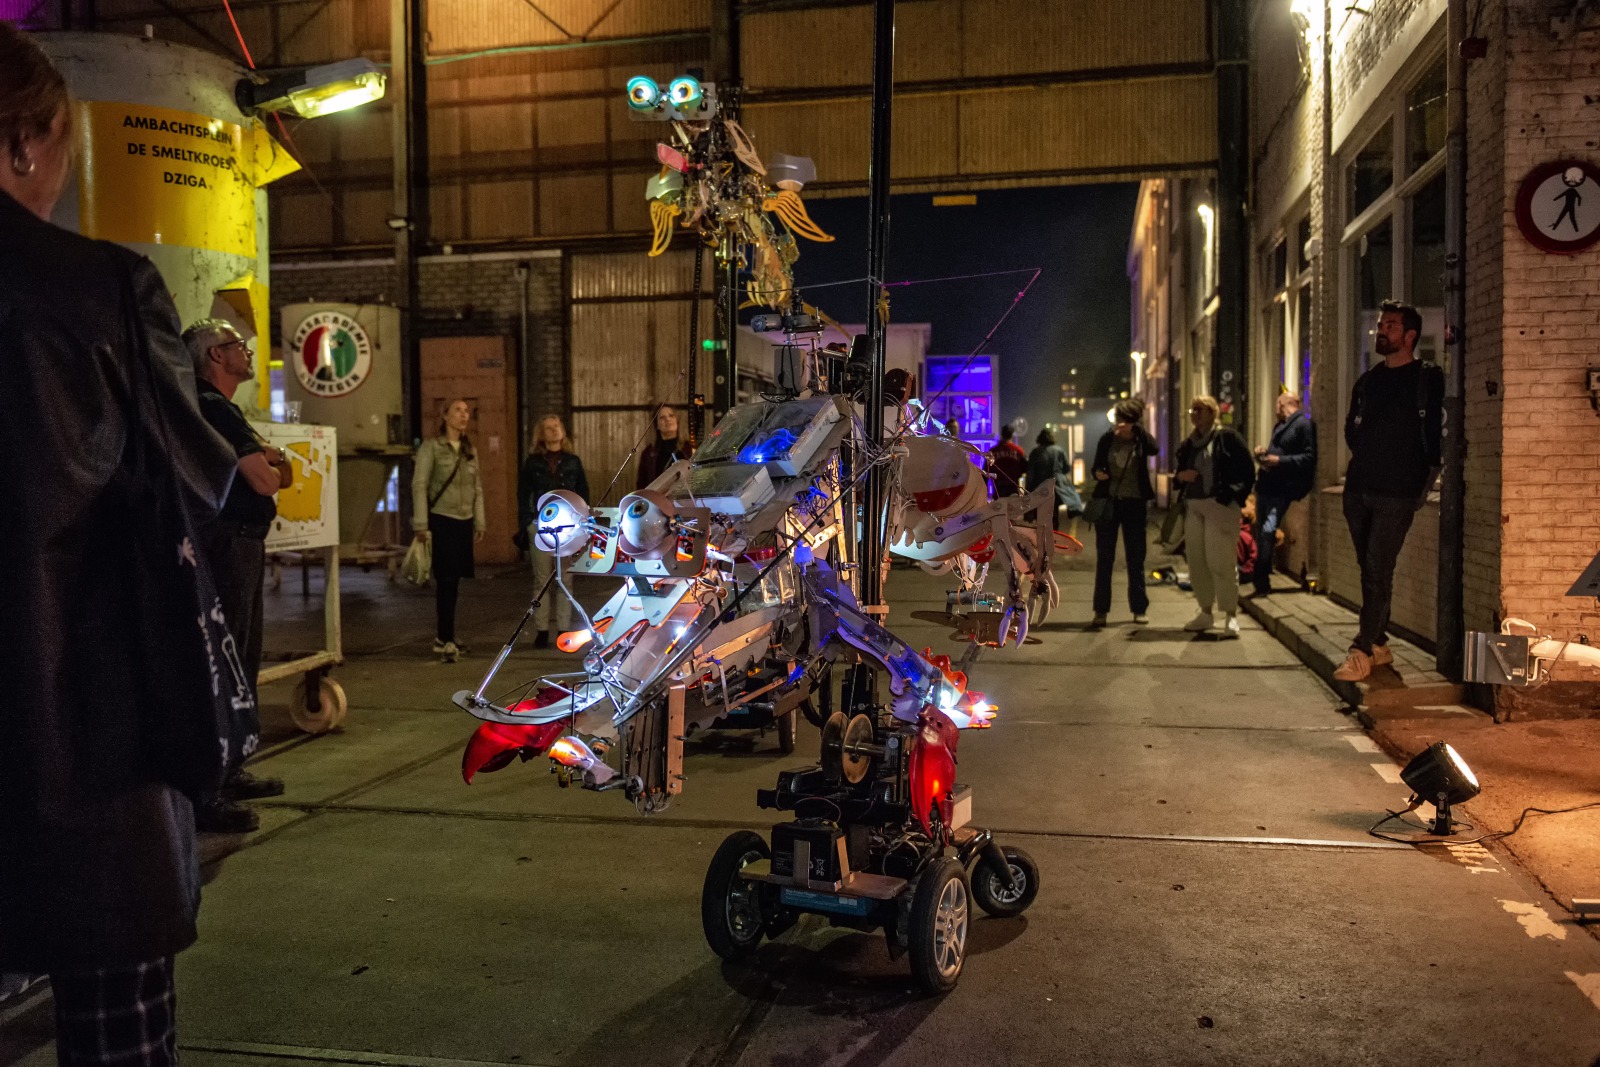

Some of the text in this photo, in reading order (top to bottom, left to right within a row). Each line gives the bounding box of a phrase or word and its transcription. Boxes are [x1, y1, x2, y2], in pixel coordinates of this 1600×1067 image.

[123, 115, 232, 145] AMBACHTSPLEIN
[127, 142, 232, 170] DE SMELTKROES
[163, 171, 207, 189] DZIGA
